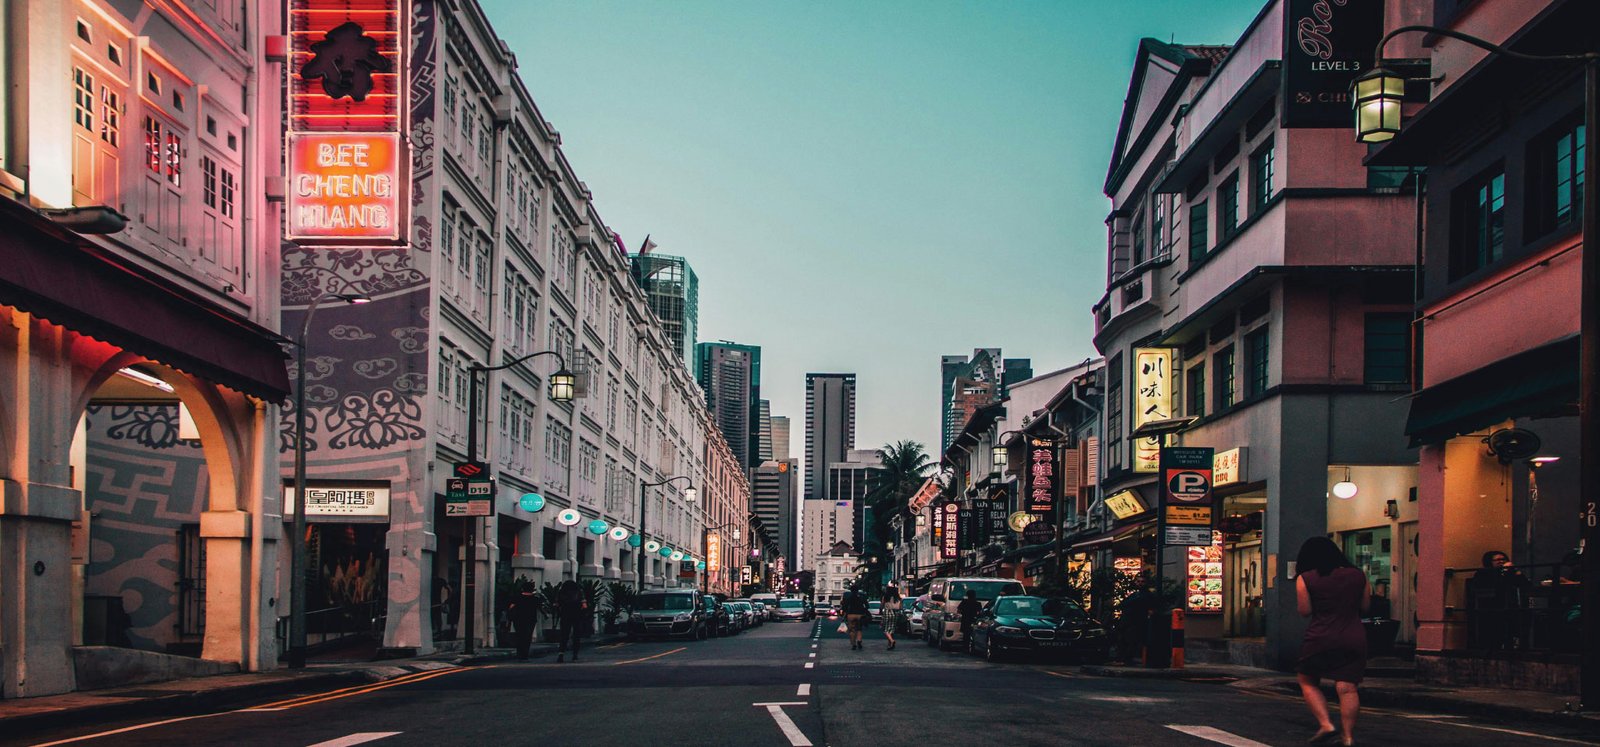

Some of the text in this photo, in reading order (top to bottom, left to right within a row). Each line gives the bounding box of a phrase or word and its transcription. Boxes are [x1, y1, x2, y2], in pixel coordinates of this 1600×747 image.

[1311, 61, 1360, 71] LEVEL 3
[317, 143, 369, 167] BEE
[297, 174, 391, 198] CHENG
[297, 204, 390, 229] HIANG
[1178, 474, 1205, 493] P
[448, 505, 456, 514] 2
[992, 502, 1005, 510] THAI
[990, 511, 1007, 520] RELAX
[1587, 502, 1597, 527] 20
[993, 520, 1004, 529] SPA
